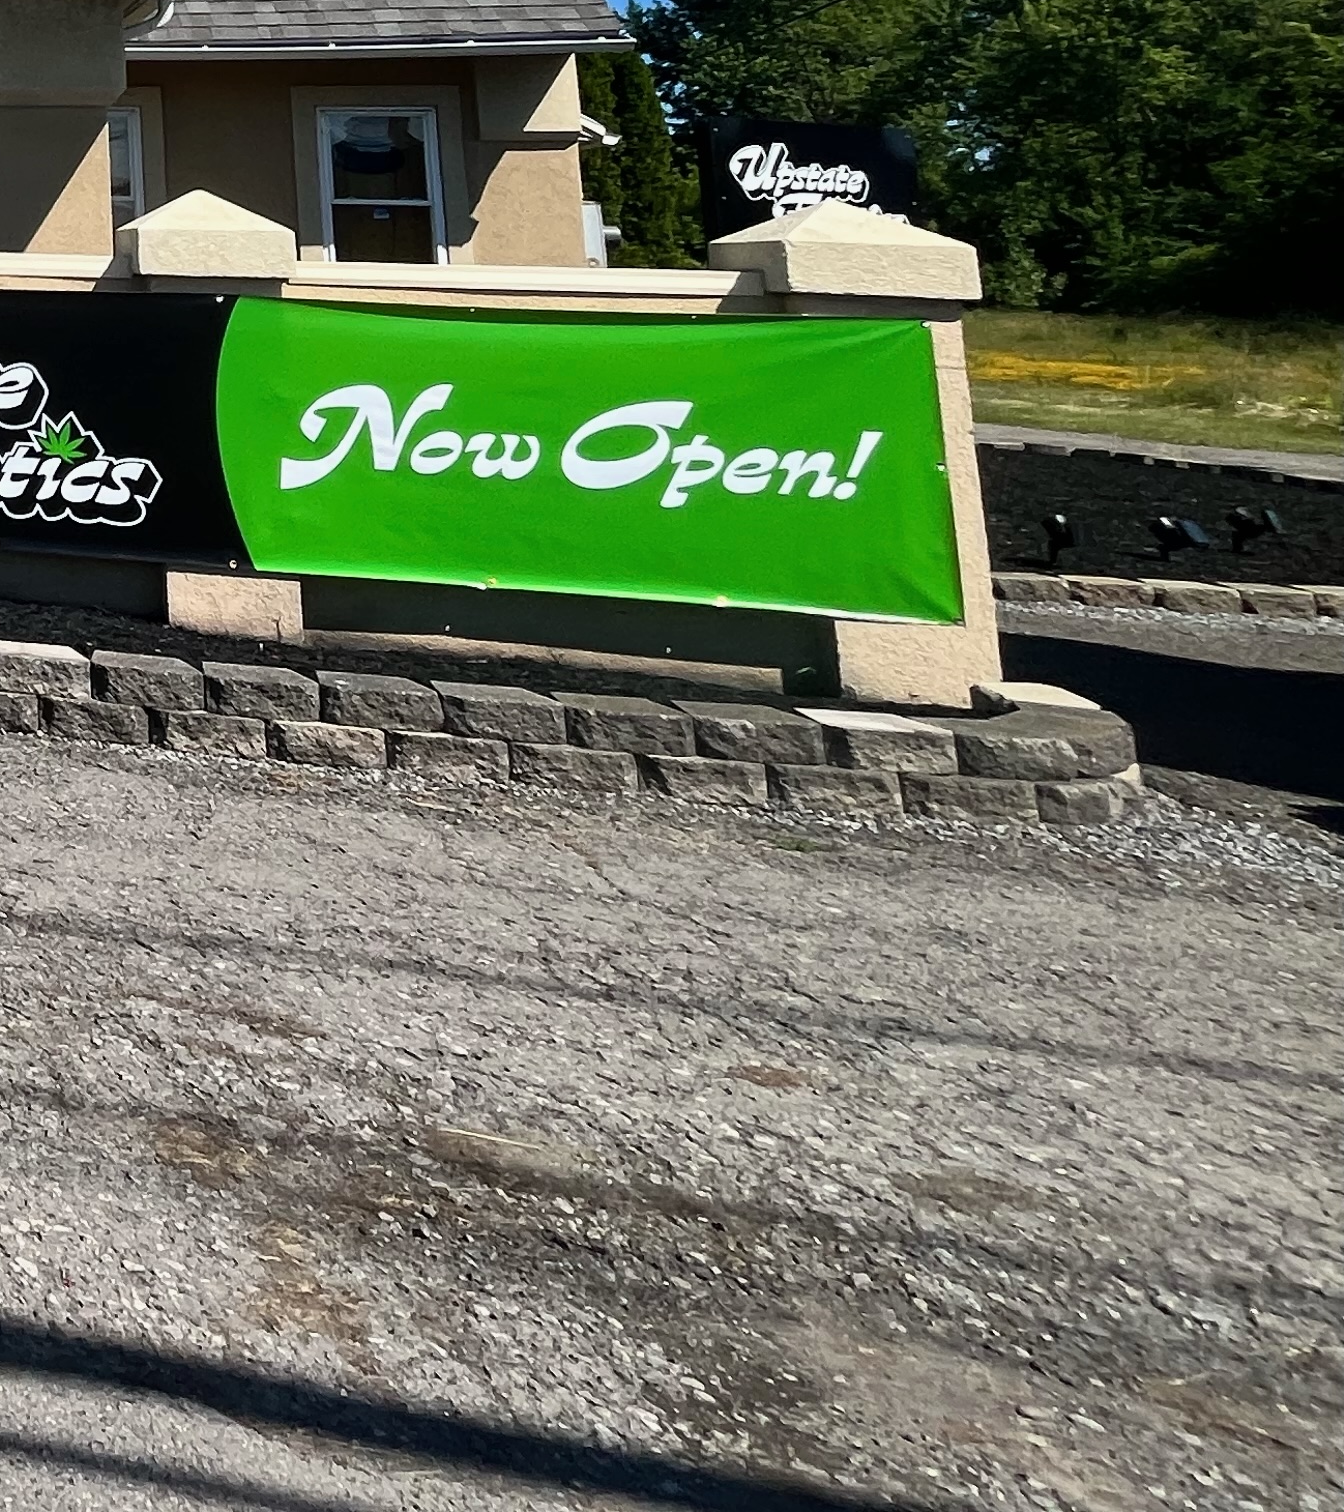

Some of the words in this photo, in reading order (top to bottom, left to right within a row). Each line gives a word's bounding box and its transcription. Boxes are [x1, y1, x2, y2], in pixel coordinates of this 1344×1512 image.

[729, 142, 869, 200] Upstate
[279, 381, 541, 490] Now
[560, 399, 883, 509] Open!
